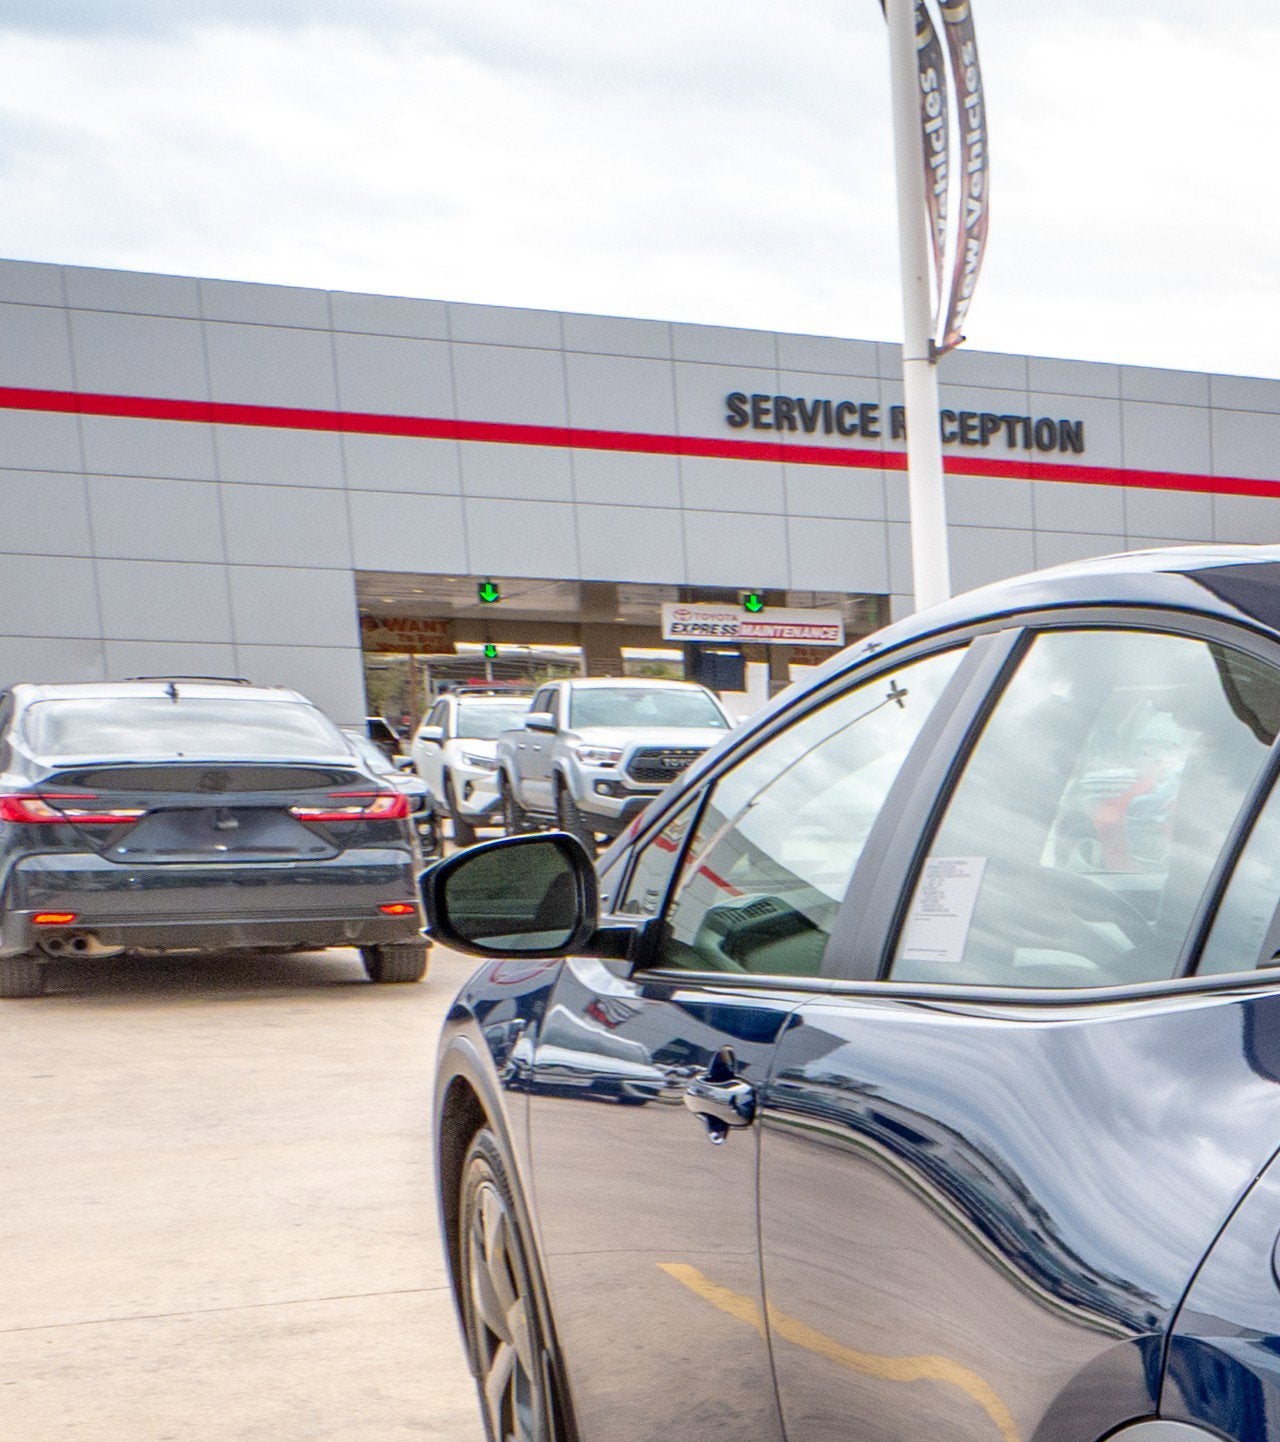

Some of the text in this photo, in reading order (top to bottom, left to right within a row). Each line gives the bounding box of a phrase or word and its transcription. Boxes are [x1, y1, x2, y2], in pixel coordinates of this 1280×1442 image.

[726, 392, 1085, 453] SERVICE RCEPTION
[671, 622, 839, 640] EXPRESS MAINTENANCE
